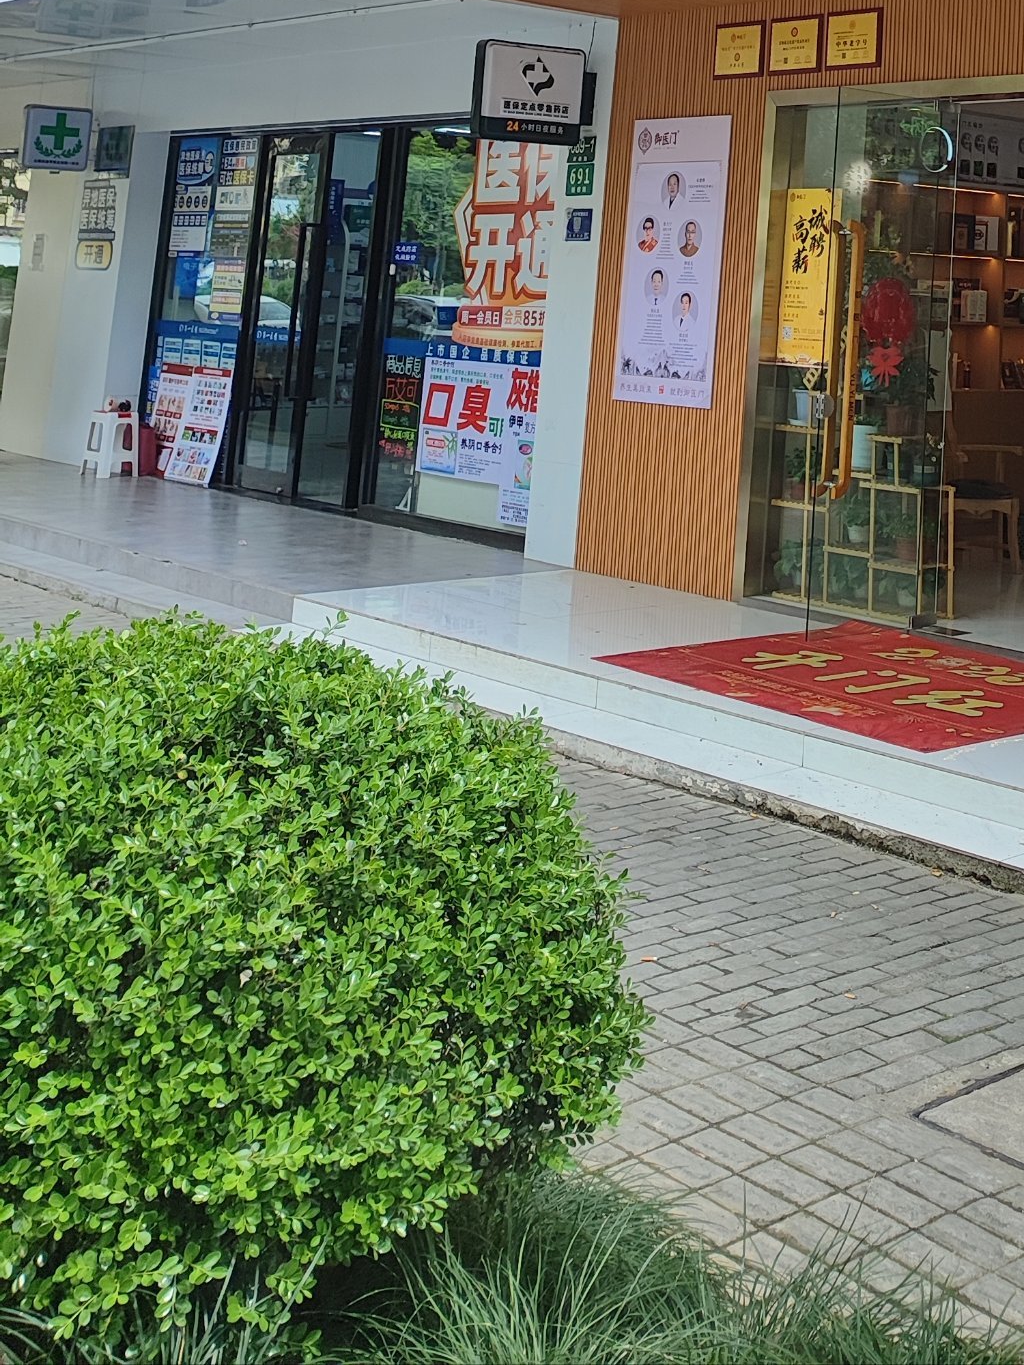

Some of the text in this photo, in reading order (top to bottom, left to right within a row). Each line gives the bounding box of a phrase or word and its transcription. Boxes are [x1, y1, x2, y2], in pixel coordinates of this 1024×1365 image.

[503, 100, 569, 115] 医保定点零售药店
[570, 167, 590, 185] 691
[460, 310, 500, 325] 周一会员日
[425, 342, 529, 365] 上市国企 品质保证
[422, 382, 491, 434] 口臭
